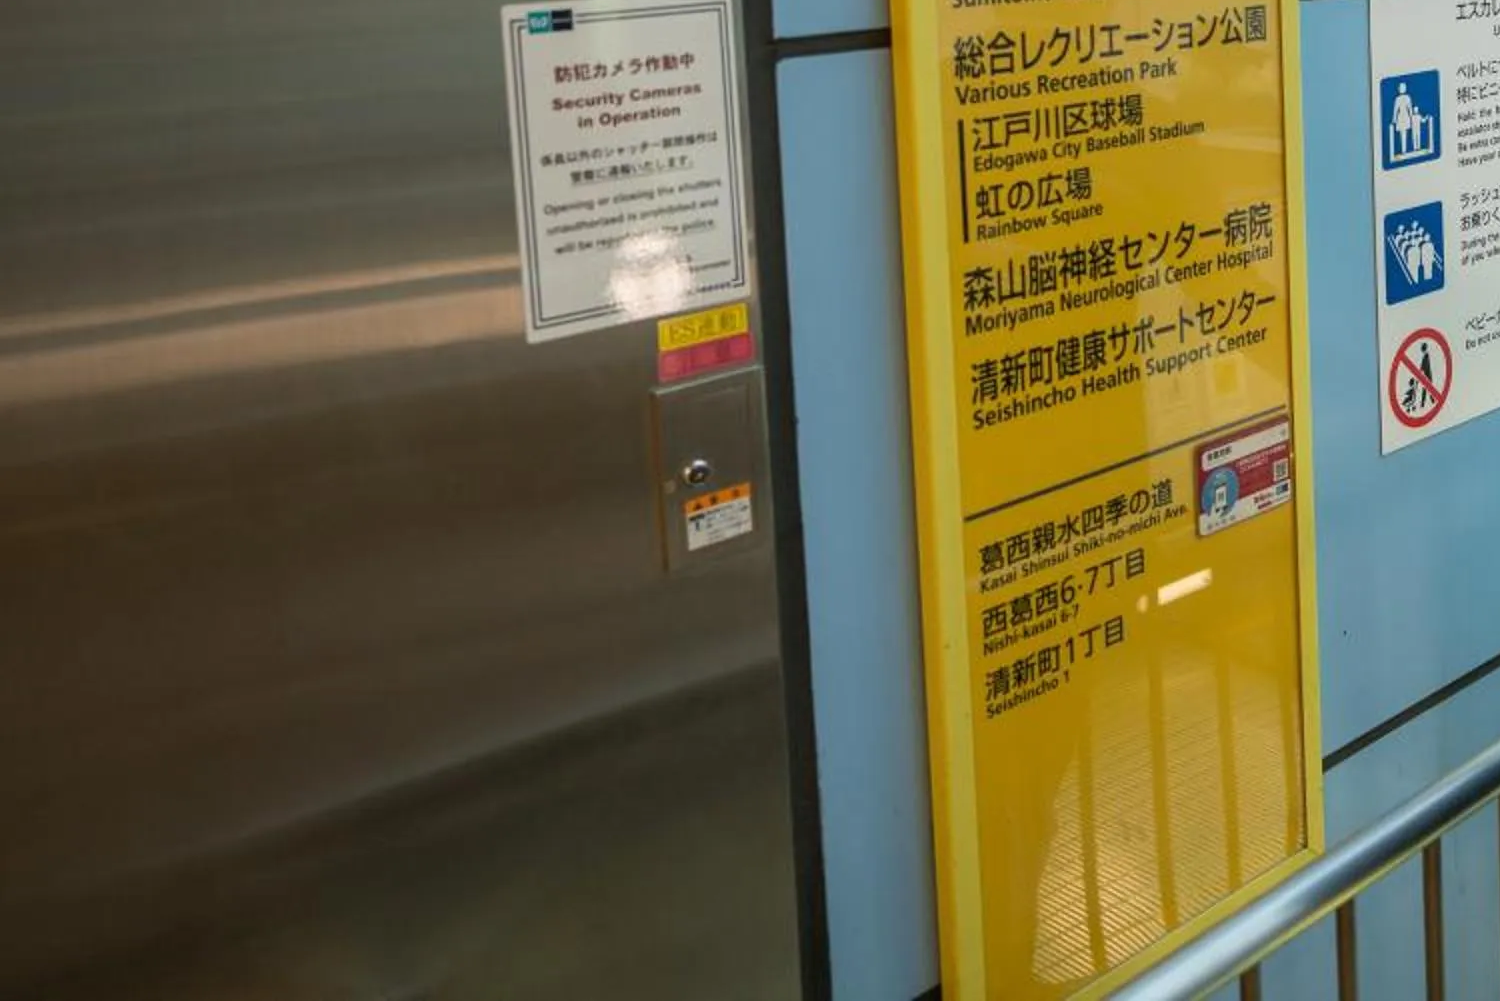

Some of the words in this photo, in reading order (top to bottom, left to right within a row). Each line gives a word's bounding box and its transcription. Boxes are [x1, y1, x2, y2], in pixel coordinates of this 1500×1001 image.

[553, 53, 696, 84] 防犯カメラ作動中
[953, 5, 1267, 81] 総合レクリエーション公園
[551, 91, 623, 114] Security
[629, 82, 702, 104] Cameras
[955, 80, 1031, 105] Various
[1037, 65, 1134, 95] Recreation
[1140, 57, 1178, 79] Park
[577, 112, 593, 129] in
[599, 104, 682, 129] Operation
[972, 94, 1144, 152] 江戸川区球場
[973, 147, 1048, 173] Edogawa
[1052, 140, 1080, 162] City
[1086, 129, 1145, 152] Baseball
[1149, 120, 1205, 143] Stadium
[975, 166, 1093, 220] 虹の広場
[977, 215, 1047, 241] Rainbow
[1052, 202, 1103, 227] Square
[964, 201, 1273, 313] 森山脳神経センター病院
[965, 298, 1055, 337] Moriyama
[1060, 273, 1161, 310] Neurological
[1164, 258, 1213, 285] Center
[1217, 241, 1274, 270] Hospital
[970, 288, 1276, 406] 清新町健康サポートセンター
[972, 384, 1076, 431] Seishincho
[1081, 363, 1141, 396] Health
[1145, 344, 1213, 377] Support
[1217, 325, 1267, 355] Center
[979, 478, 1174, 574] 葛西親水四季の道
[980, 570, 1017, 595] Kasai
[1021, 550, 1069, 581] Shinsui
[1073, 514, 1161, 558] Shiki-no-michi
[983, 614, 1057, 658] Nishi-kasai
[985, 615, 1124, 702] 清新町1丁目
[985, 676, 1060, 720] Seishincho
[1063, 670, 1071, 684] 1
